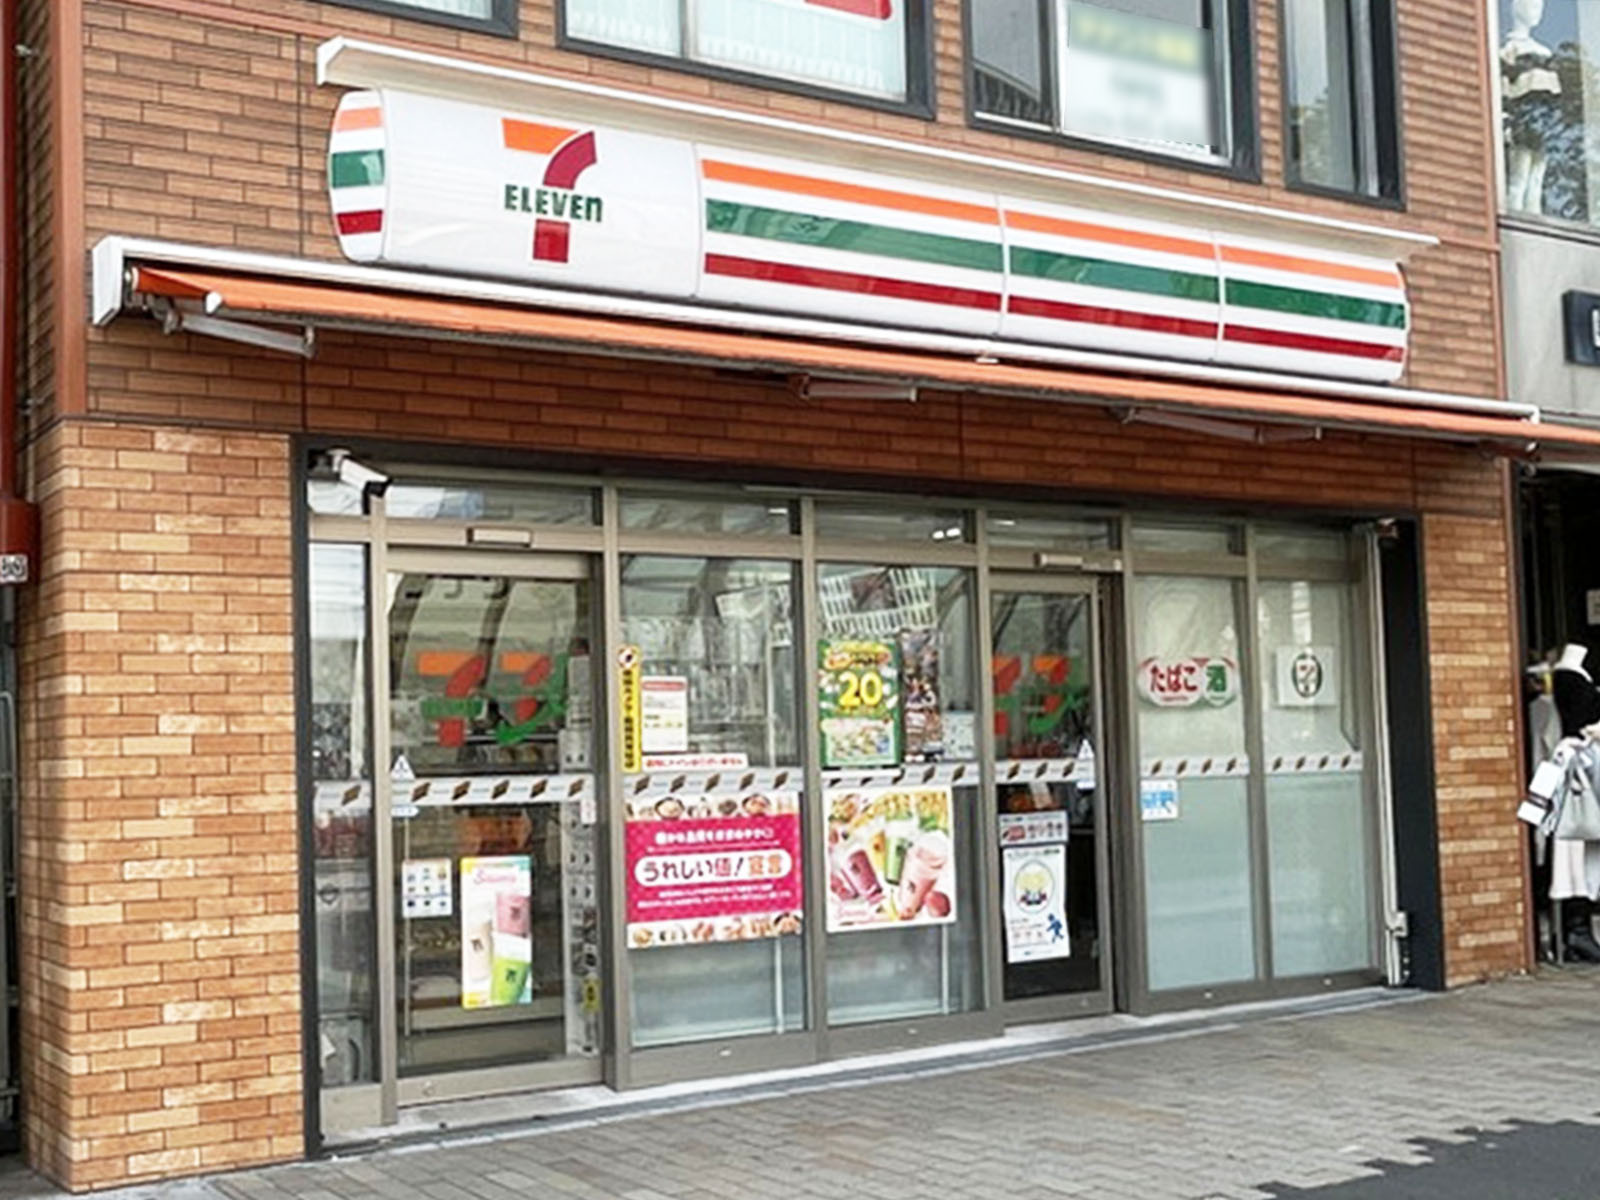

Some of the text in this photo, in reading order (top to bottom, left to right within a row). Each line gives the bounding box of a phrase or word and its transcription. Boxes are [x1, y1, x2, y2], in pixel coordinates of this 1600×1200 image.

[505, 183, 604, 223] ELEVEN
[838, 671, 883, 707] 20
[1150, 664, 1198, 692] たばこ
